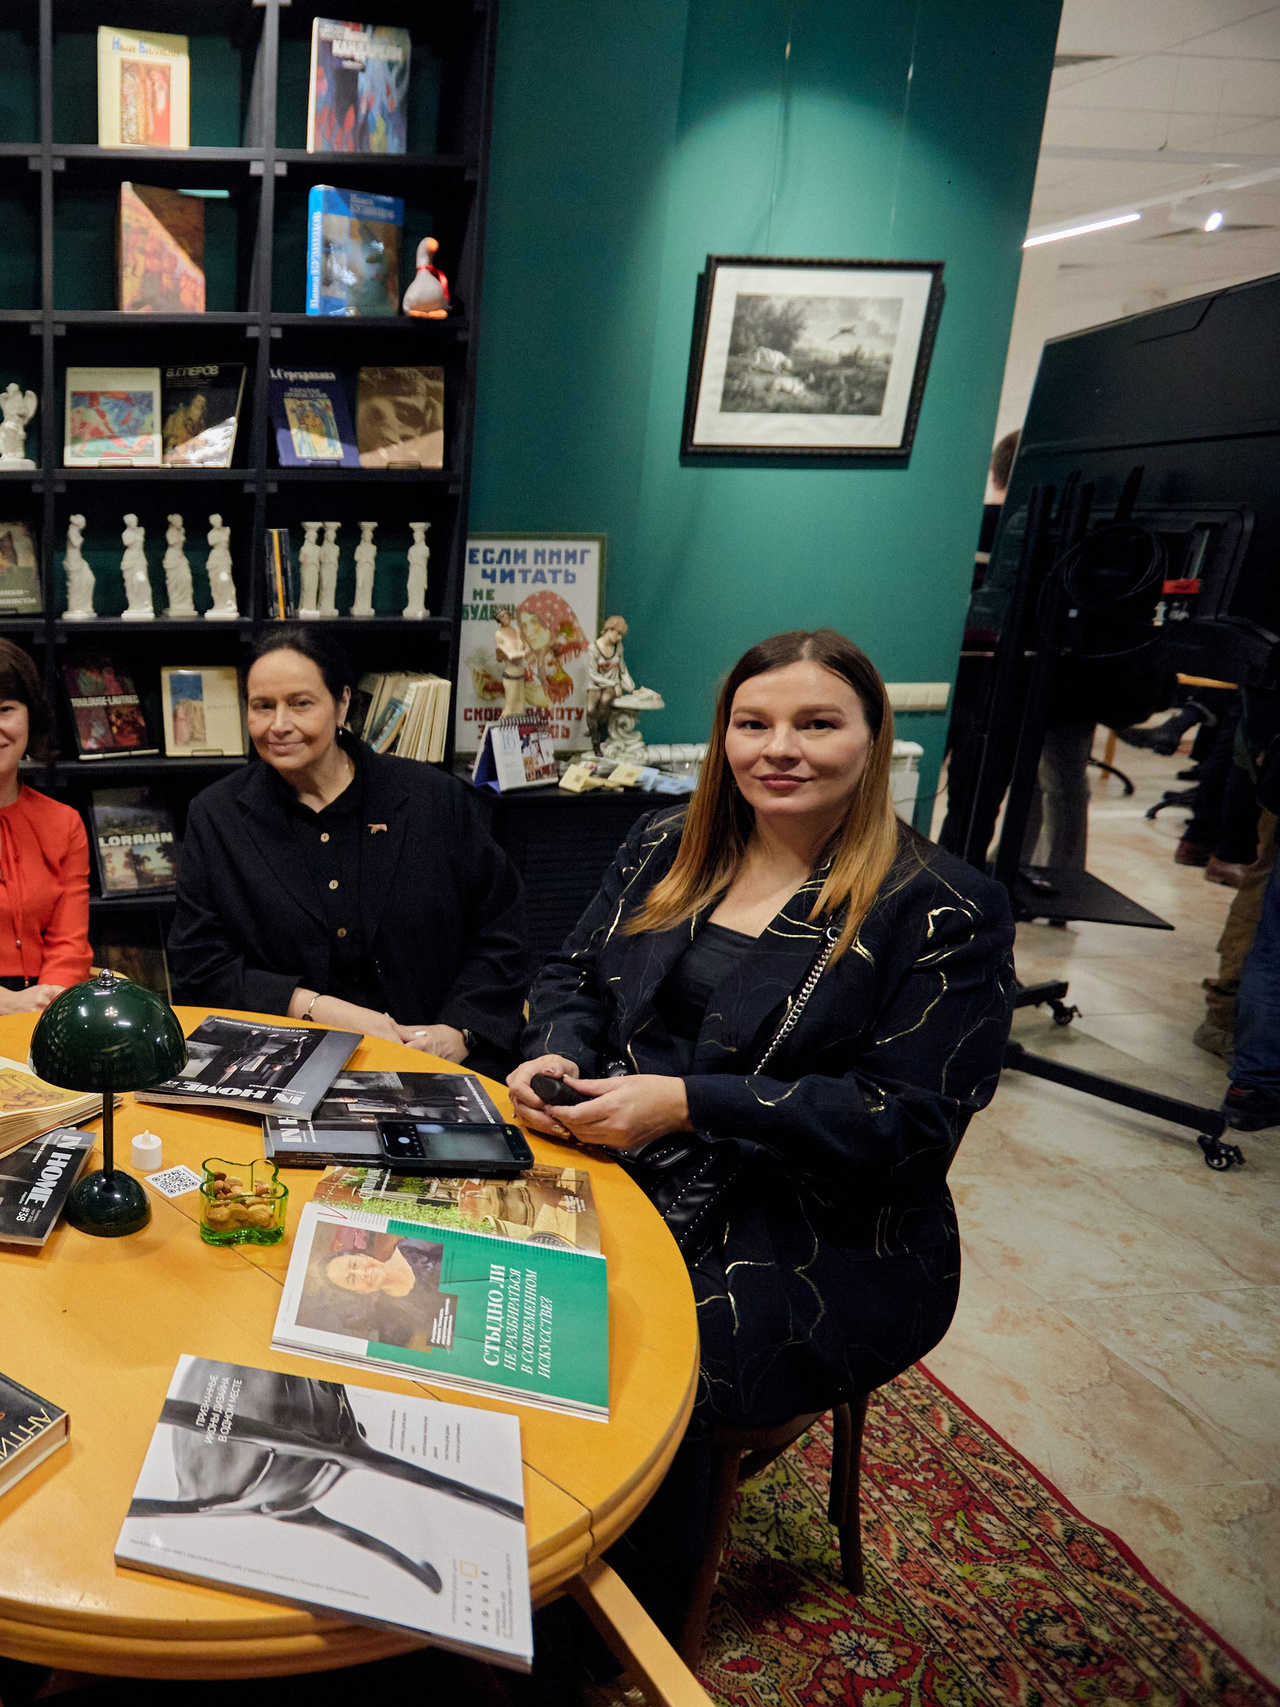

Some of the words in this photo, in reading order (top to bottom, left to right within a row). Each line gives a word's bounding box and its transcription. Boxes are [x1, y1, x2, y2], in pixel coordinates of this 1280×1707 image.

[468, 547, 527, 565] ЕСЛИ
[533, 548, 591, 565] КНИГ
[481, 568, 577, 584] ЧИТАТЬ
[472, 588, 495, 601] НЕ
[98, 832, 173, 847] LORRAIN
[177, 1080, 267, 1100] HOME
[272, 1093, 305, 1106] IN
[56, 1134, 83, 1150] IN
[280, 1127, 303, 1143] IN
[24, 1151, 73, 1209] HOME
[16, 1206, 31, 1222] #38
[489, 1263, 506, 1289] ЛИ
[504, 1267, 523, 1353] РАЗБИРАТЬСЯ
[521, 1268, 538, 1362] СОВРЕМЕННОМ
[483, 1289, 505, 1367] СТЫДНО
[537, 1295, 554, 1380] ИСКУССТВЕ?
[503, 1351, 518, 1372] НЕ
[520, 1363, 534, 1376] В
[195, 1374, 219, 1427] ПРИЗНАННЫЕ
[212, 1376, 231, 1414] ДИЗАЙНА
[228, 1378, 243, 1404] МЕСТЕ
[204, 1412, 221, 1445] ИКОНЫ
[220, 1403, 236, 1435] ОДНОМ
[217, 1434, 228, 1443] В
